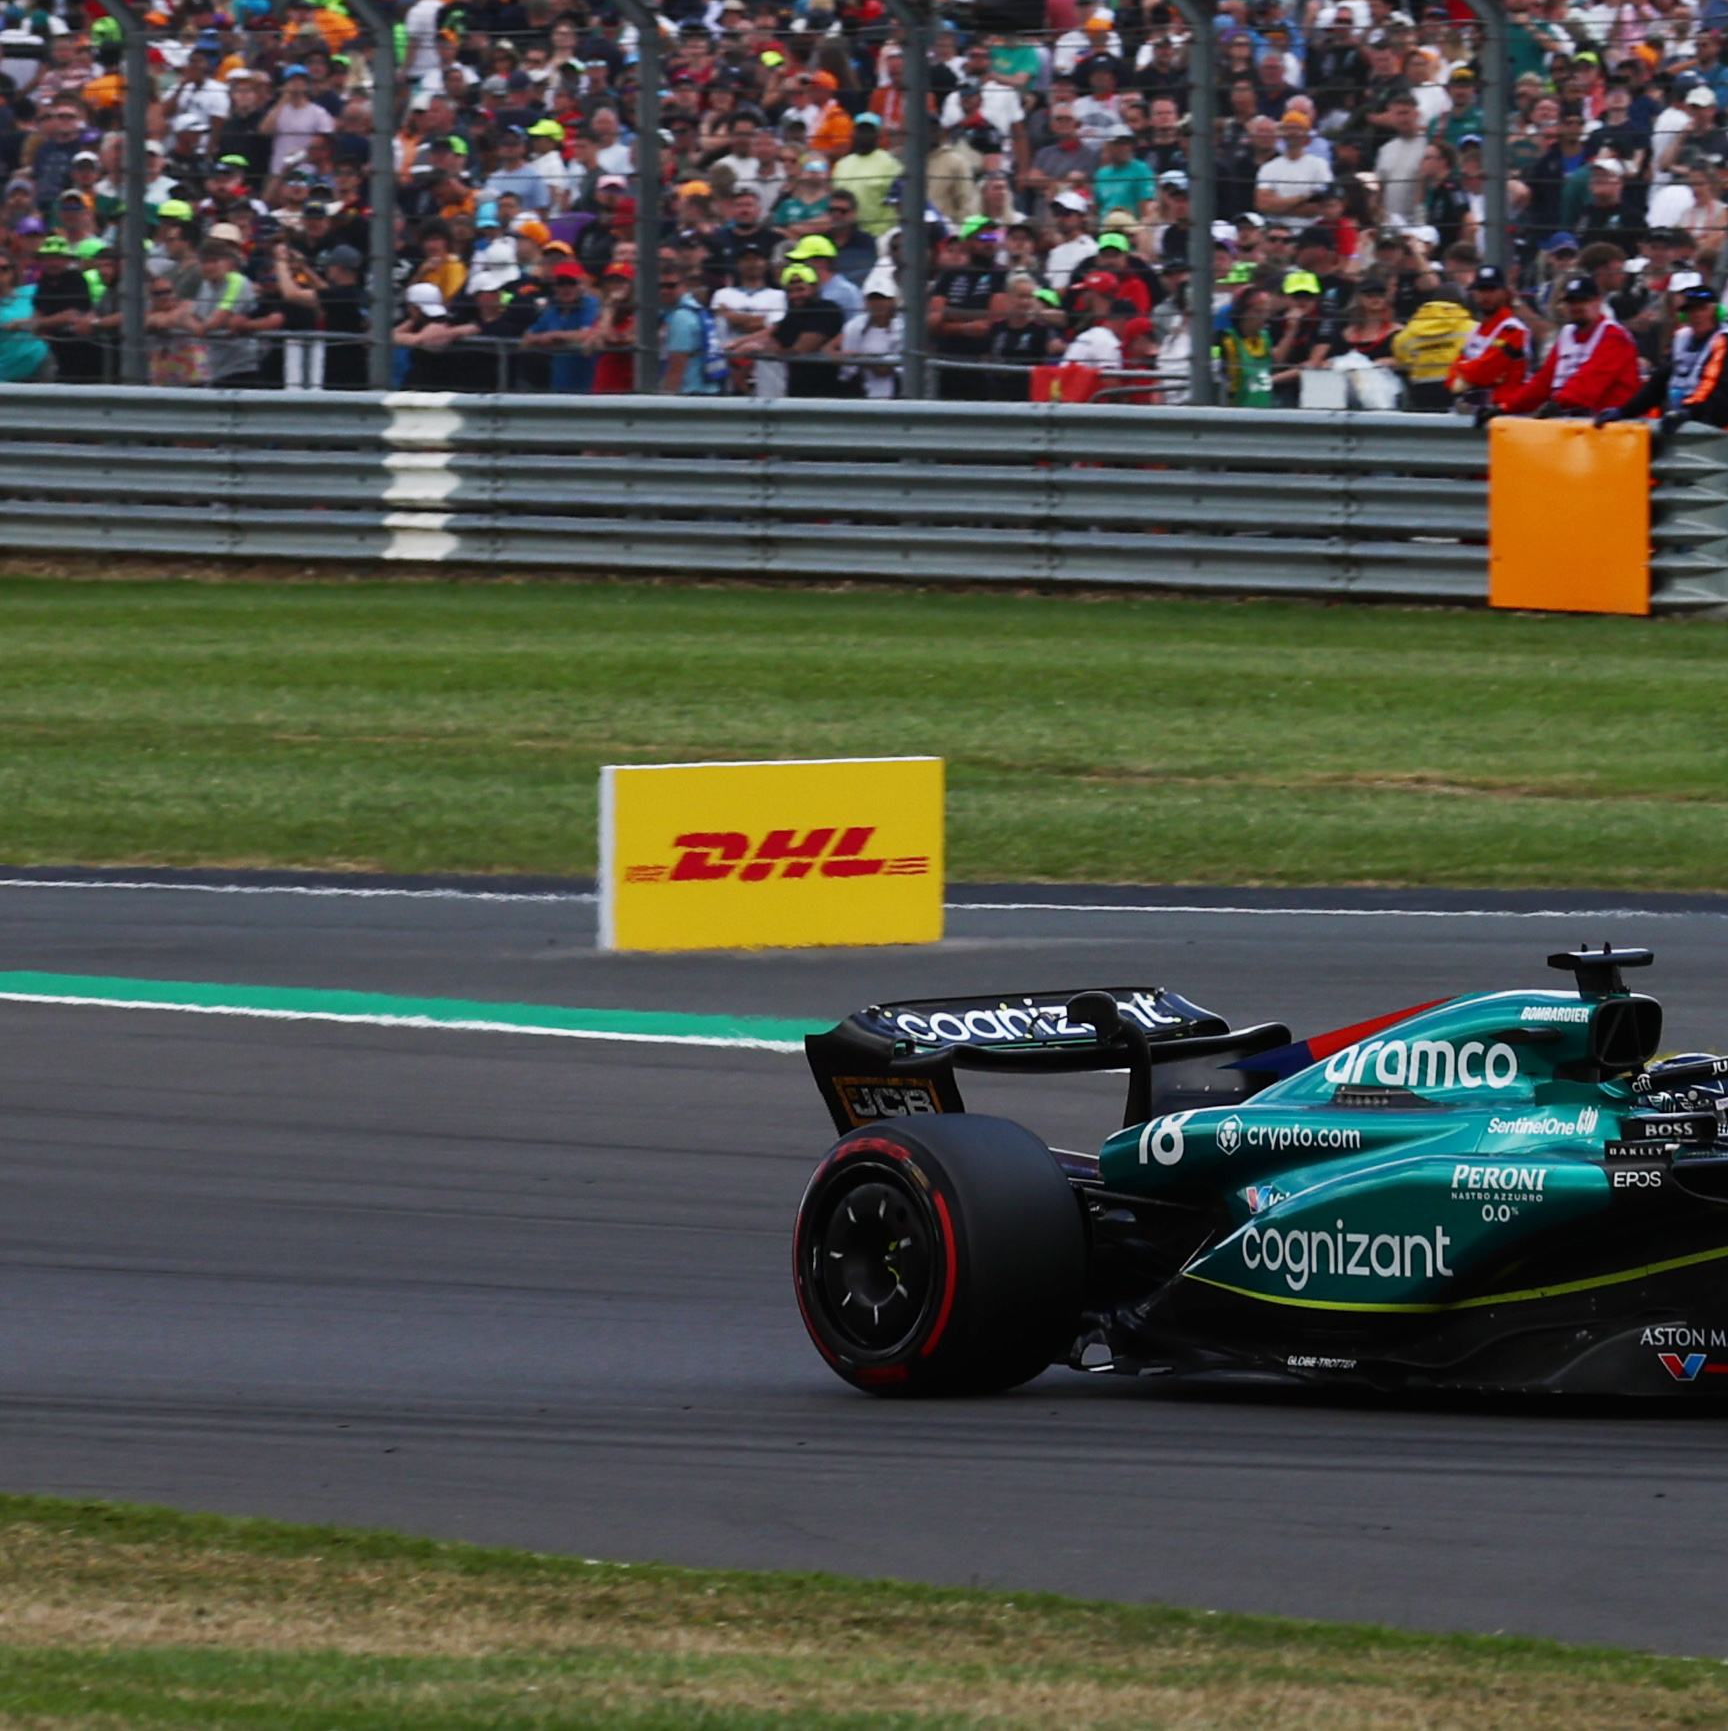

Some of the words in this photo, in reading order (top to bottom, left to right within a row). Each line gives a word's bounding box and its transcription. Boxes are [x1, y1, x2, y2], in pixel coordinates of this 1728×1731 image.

[669, 826, 886, 883] DHL
[896, 992, 1182, 1042] cogniznt
[1519, 1006, 1590, 1023] BOMBARDIER
[1324, 1039, 1518, 1089] aramco
[852, 1087, 936, 1117] JCB
[1139, 1109, 1198, 1166] 18
[1246, 1123, 1361, 1150] crypto.com
[1487, 1117, 1576, 1136] SentinelOne
[1645, 1122, 1694, 1137] BOSS
[1609, 1146, 1664, 1156] OAKLEY
[1451, 1164, 1547, 1191] PERONI
[1613, 1171, 1662, 1188] EPOS
[1451, 1191, 1490, 1201] NASTRO
[1493, 1192, 1544, 1203] AZZURRO
[1242, 1218, 1454, 1292] cognizant
[1640, 1327, 1706, 1347] ASTON
[1287, 1355, 1357, 1370] GLOBE-TROTTER
